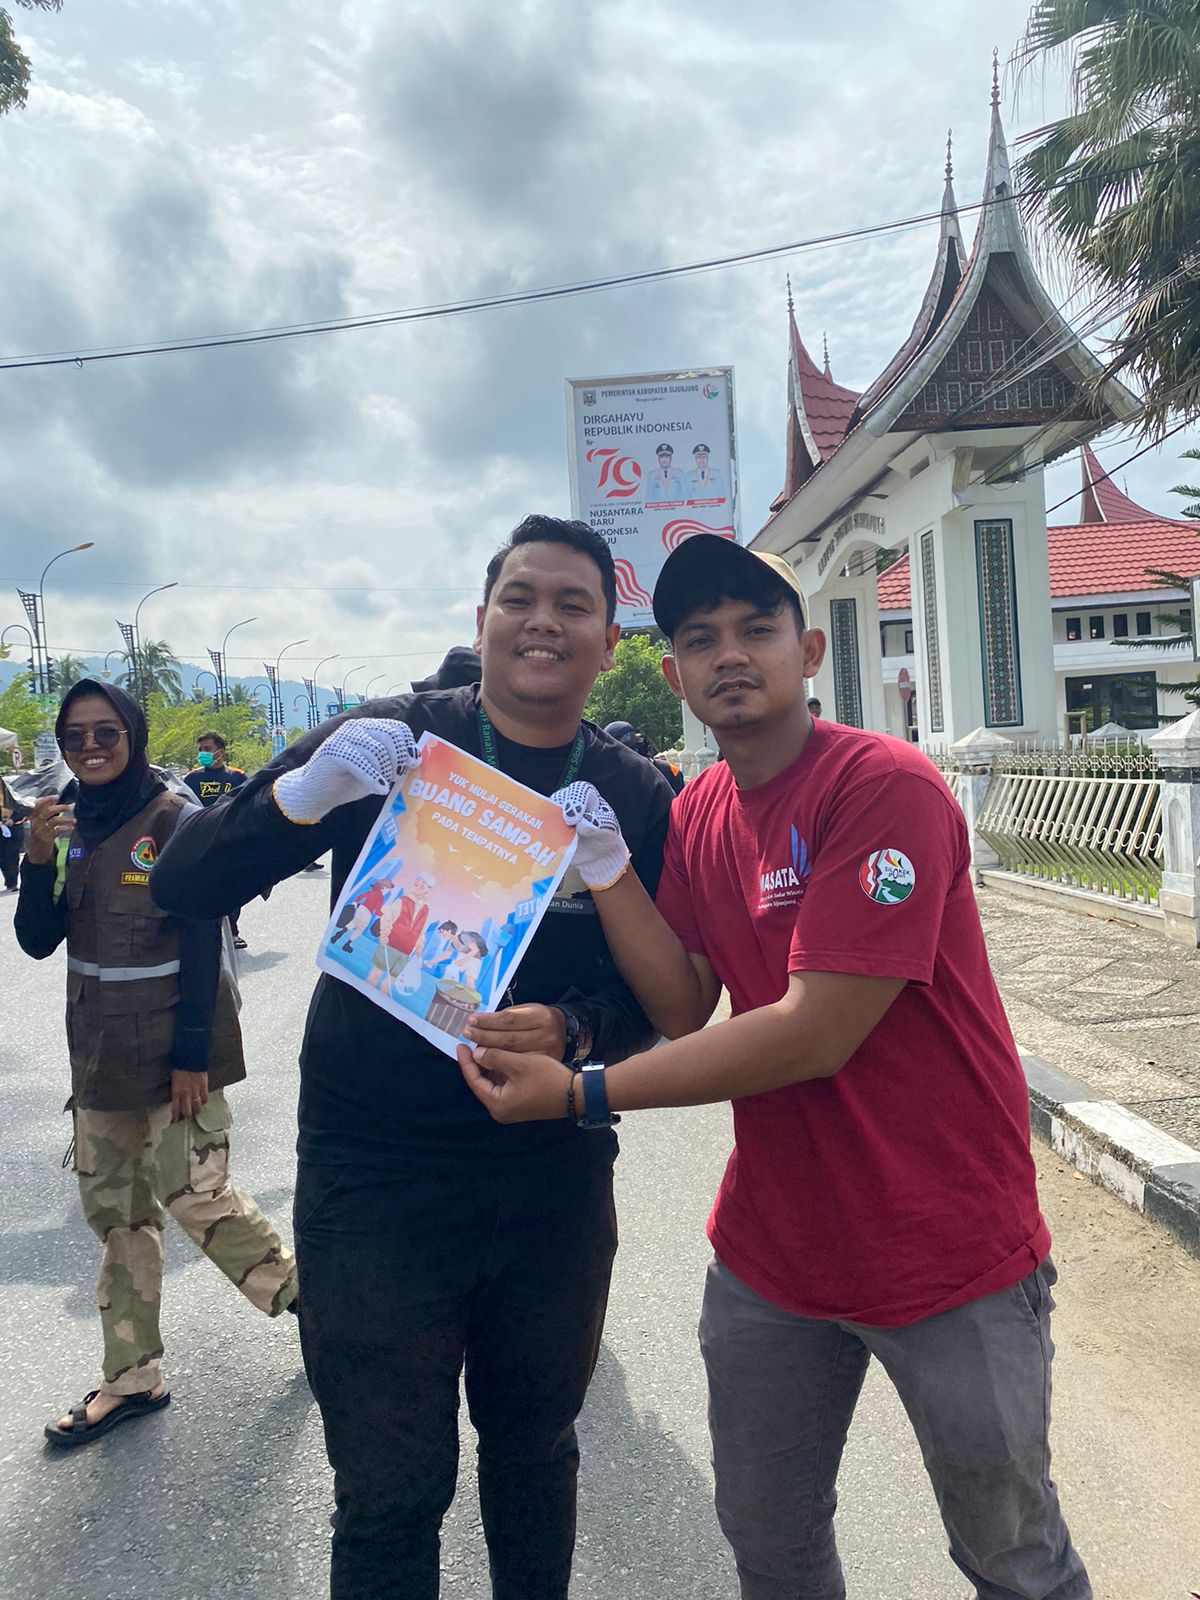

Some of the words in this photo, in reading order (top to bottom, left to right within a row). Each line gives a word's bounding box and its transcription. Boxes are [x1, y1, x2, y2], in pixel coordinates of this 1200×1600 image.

[601, 388, 636, 398] PEMERINTAH
[637, 386, 668, 396] KABUPATEN
[669, 384, 699, 394] SIJUNJUNG
[583, 412, 644, 425] DIRGAHAYU
[584, 424, 633, 437] REPUBLIK
[635, 421, 692, 434] INDONESIA
[586, 448, 642, 499] 79
[589, 507, 644, 518] NUSANTARA
[590, 518, 614, 527] BARU
[481, 724, 496, 753] Ranah
[449, 772, 469, 789] YUK
[468, 784, 499, 804] MULAI
[499, 800, 544, 830] GERAKAN
[407, 778, 478, 818] BUANG
[478, 809, 557, 868] SAMPAH
[431, 811, 459, 833] PADA
[462, 827, 518, 865] TEMPATNYA
[562, 900, 583, 909] Dunia
